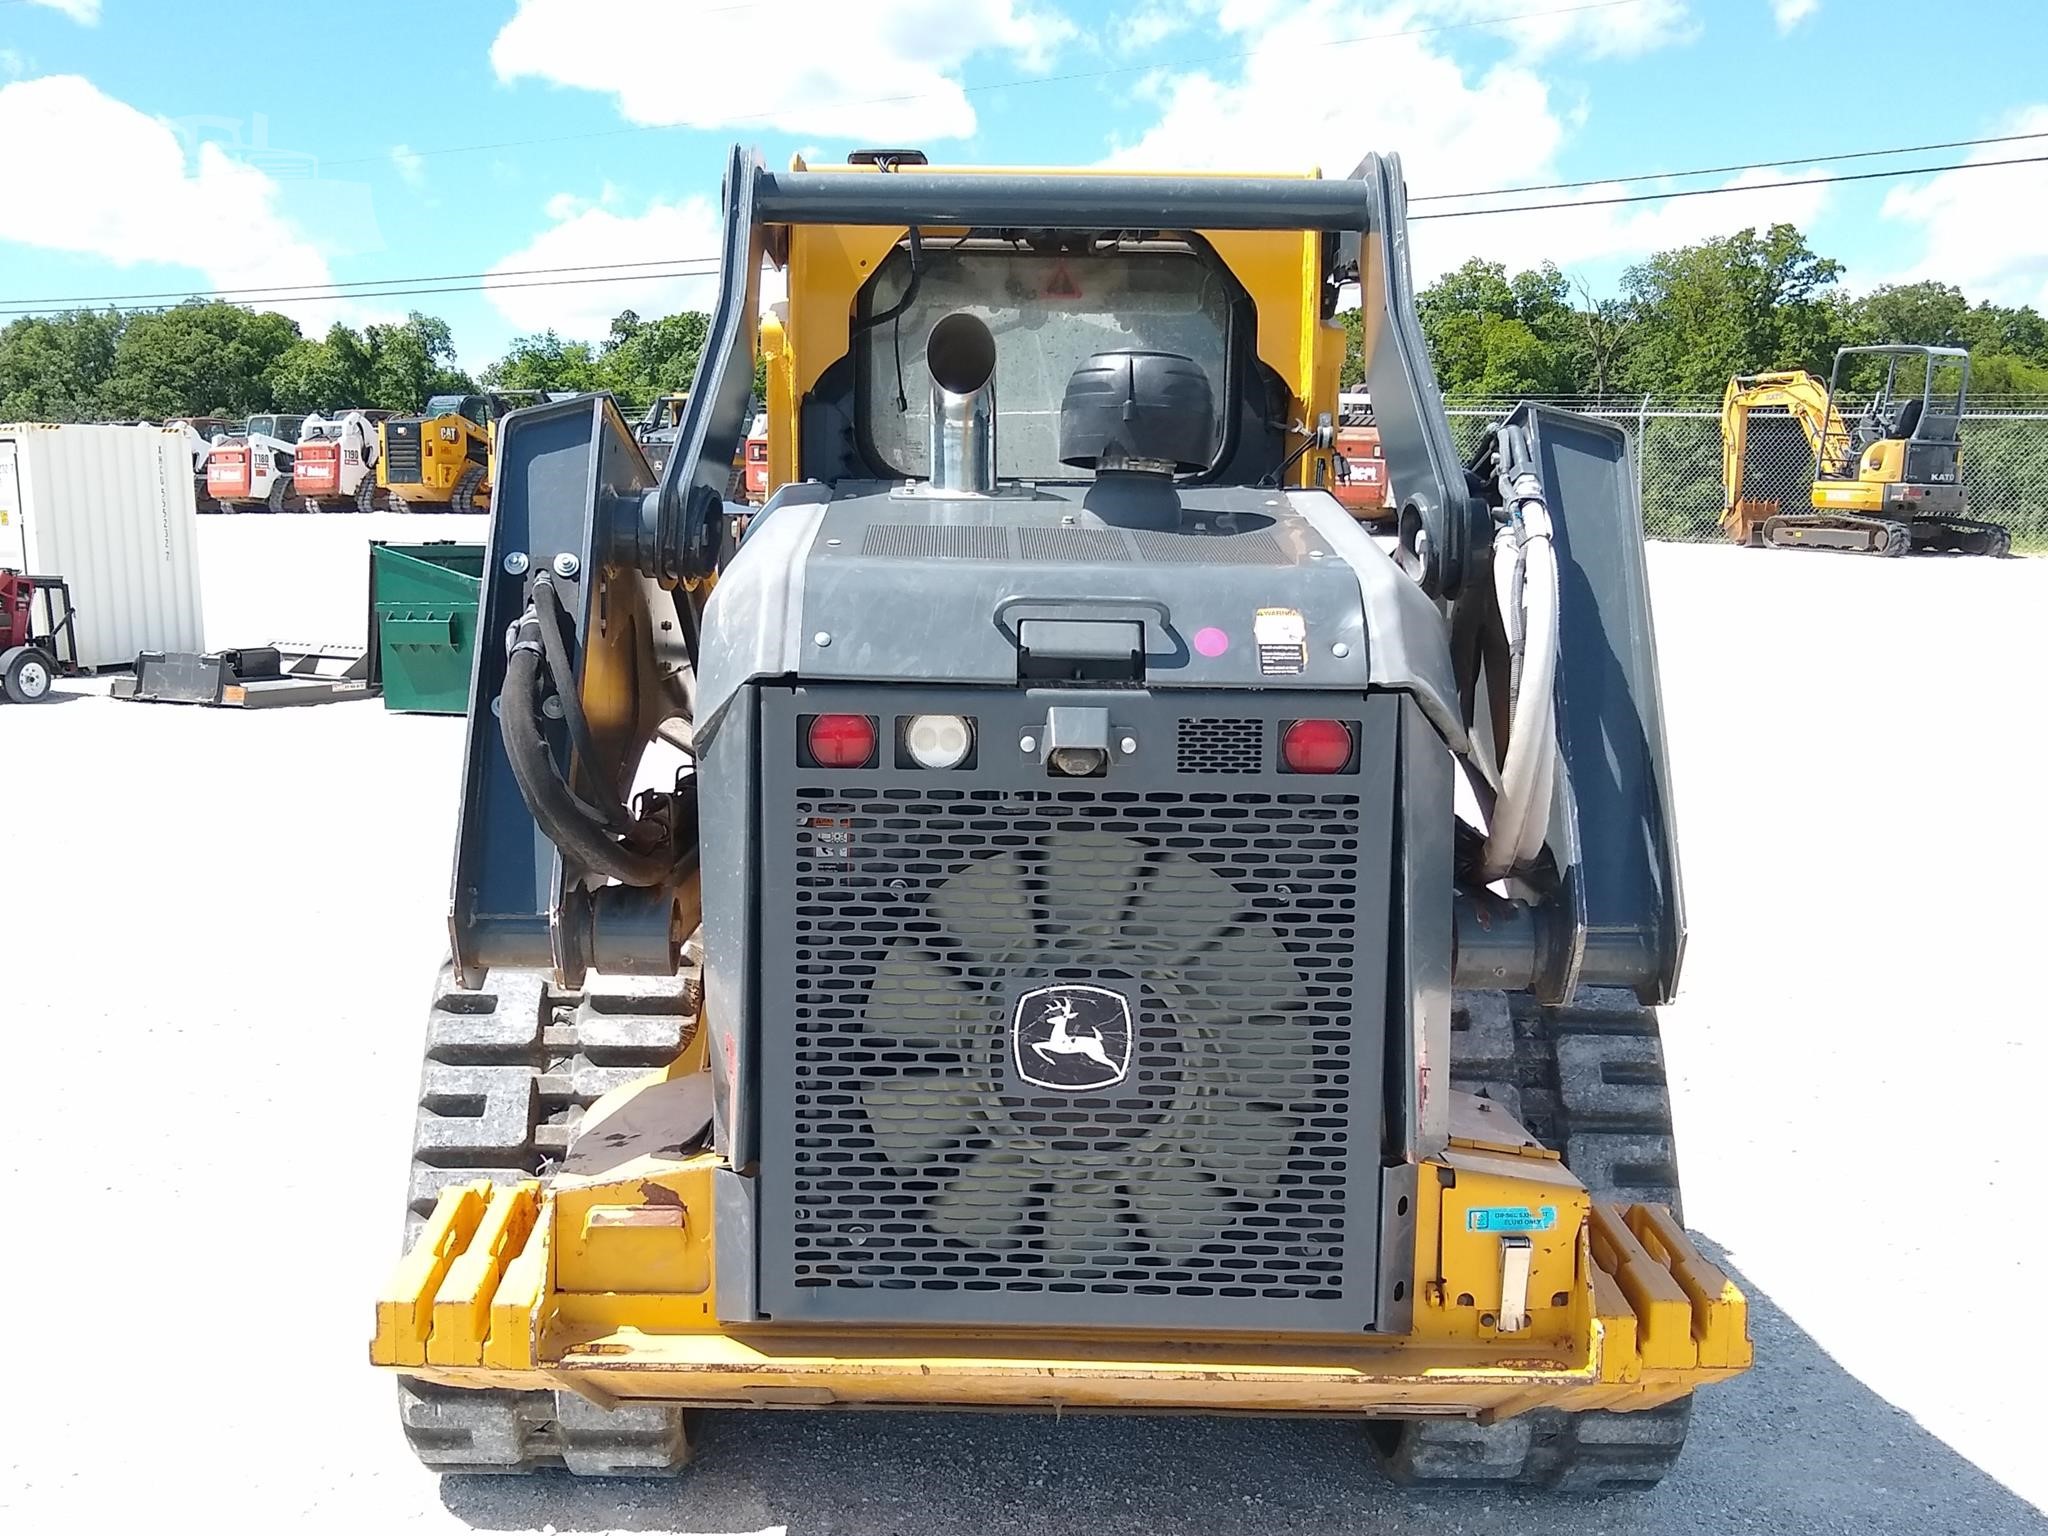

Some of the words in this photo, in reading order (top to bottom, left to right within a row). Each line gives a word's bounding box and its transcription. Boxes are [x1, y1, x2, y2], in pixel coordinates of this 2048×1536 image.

[440, 427, 456, 441] CAT
[254, 453, 269, 464] T180
[343, 449, 359, 460] T190
[1930, 473, 1955, 482] KATO
